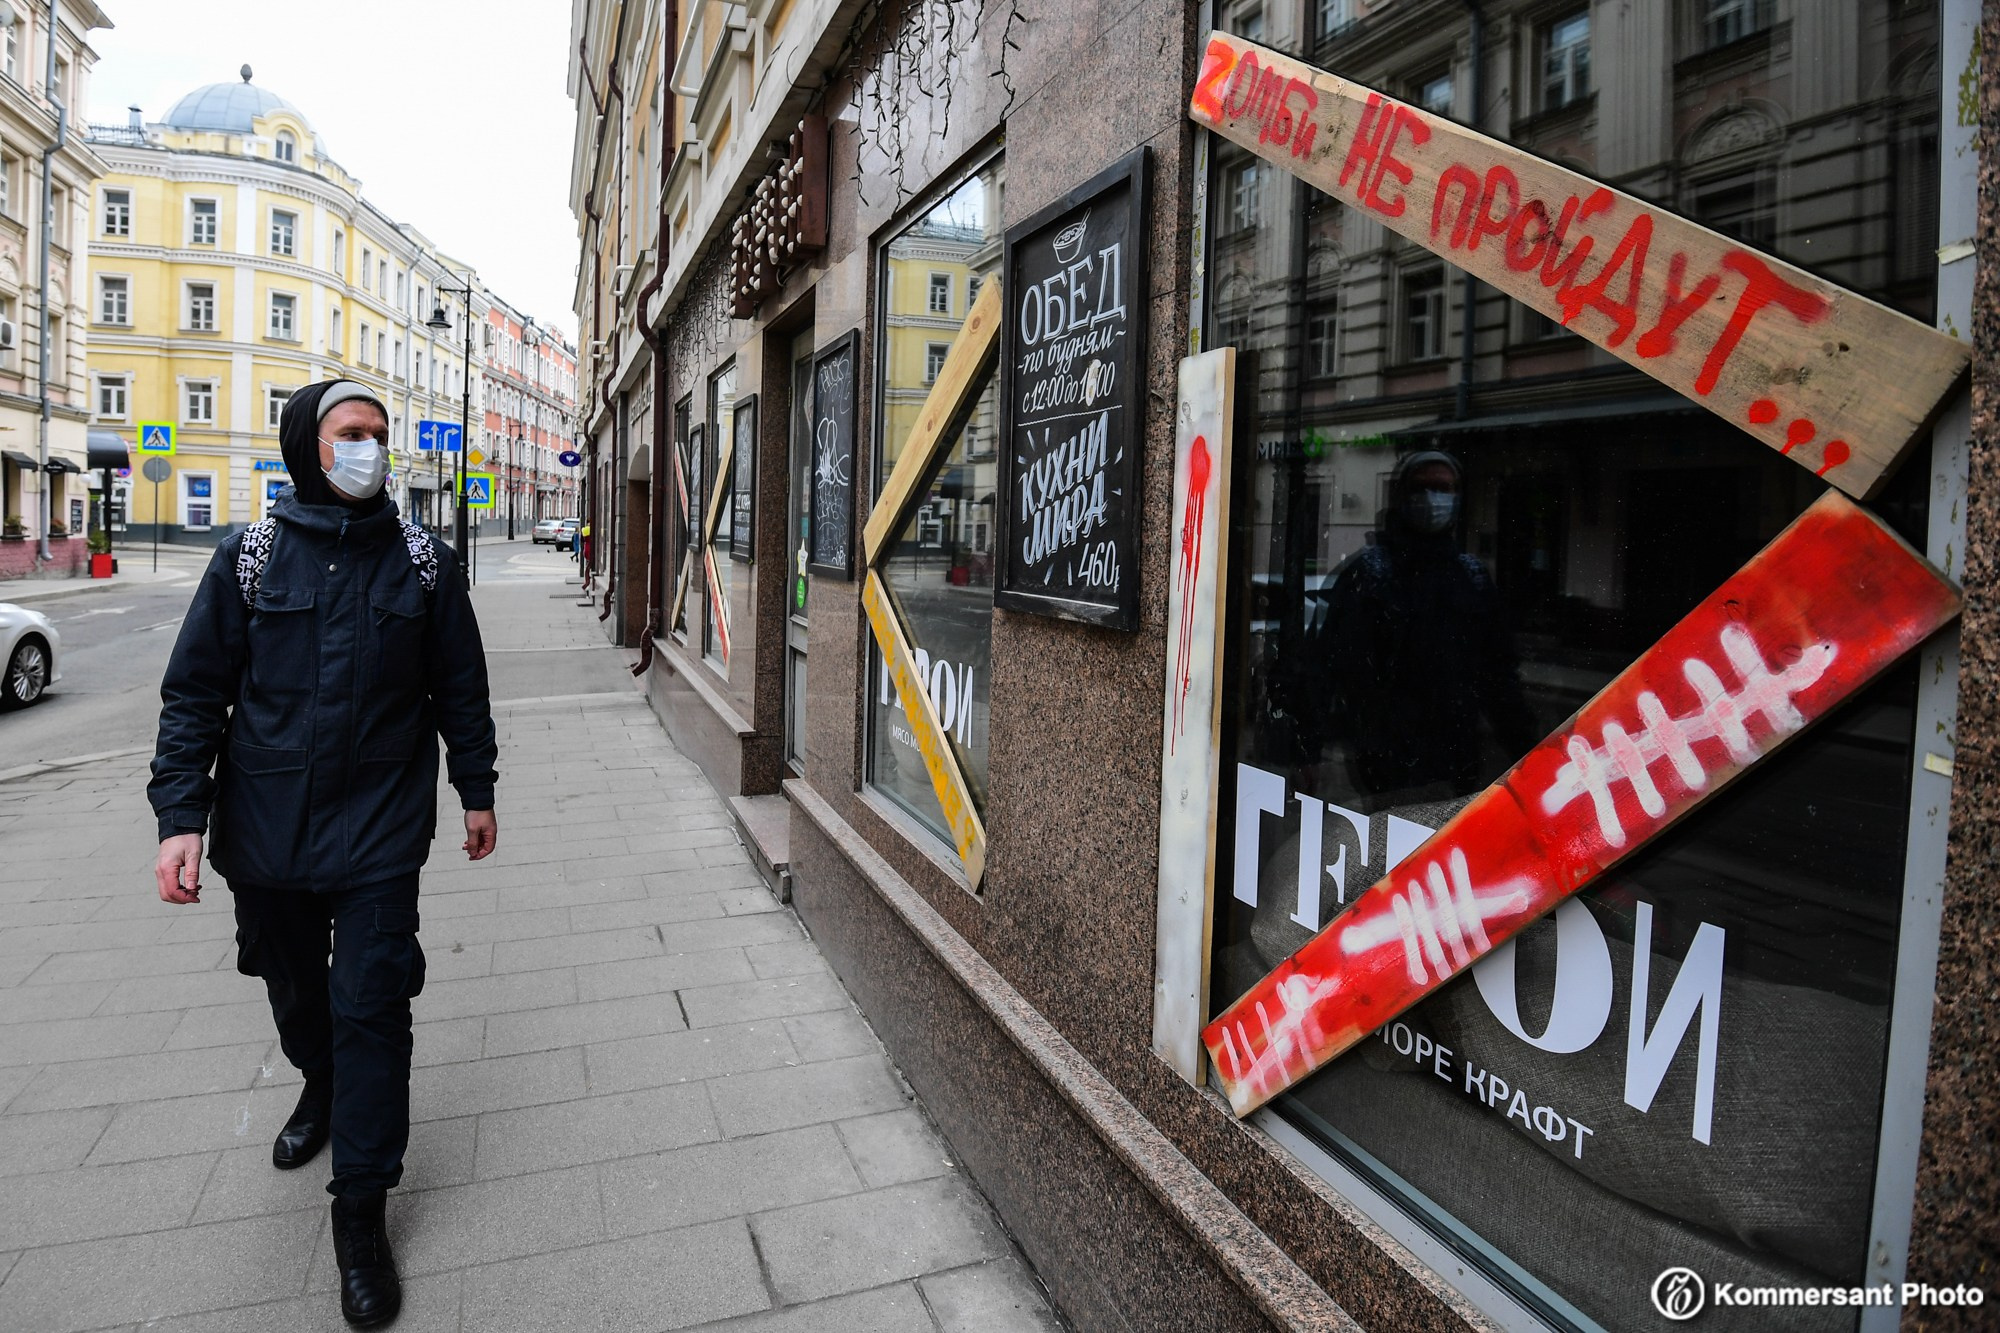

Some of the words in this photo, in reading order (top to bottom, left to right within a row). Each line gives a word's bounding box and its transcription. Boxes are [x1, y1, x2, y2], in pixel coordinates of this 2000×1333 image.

[1339, 93, 1432, 217] НЕ
[1021, 243, 1126, 345] ОБЕД
[1030, 374, 1064, 413] 12:00
[1018, 411, 1109, 523] КУХНИ
[1023, 470, 1109, 567] МИРА
[1234, 762, 1725, 1146] ГЕОИ
[1465, 1060, 1594, 1159] КРАФТ
